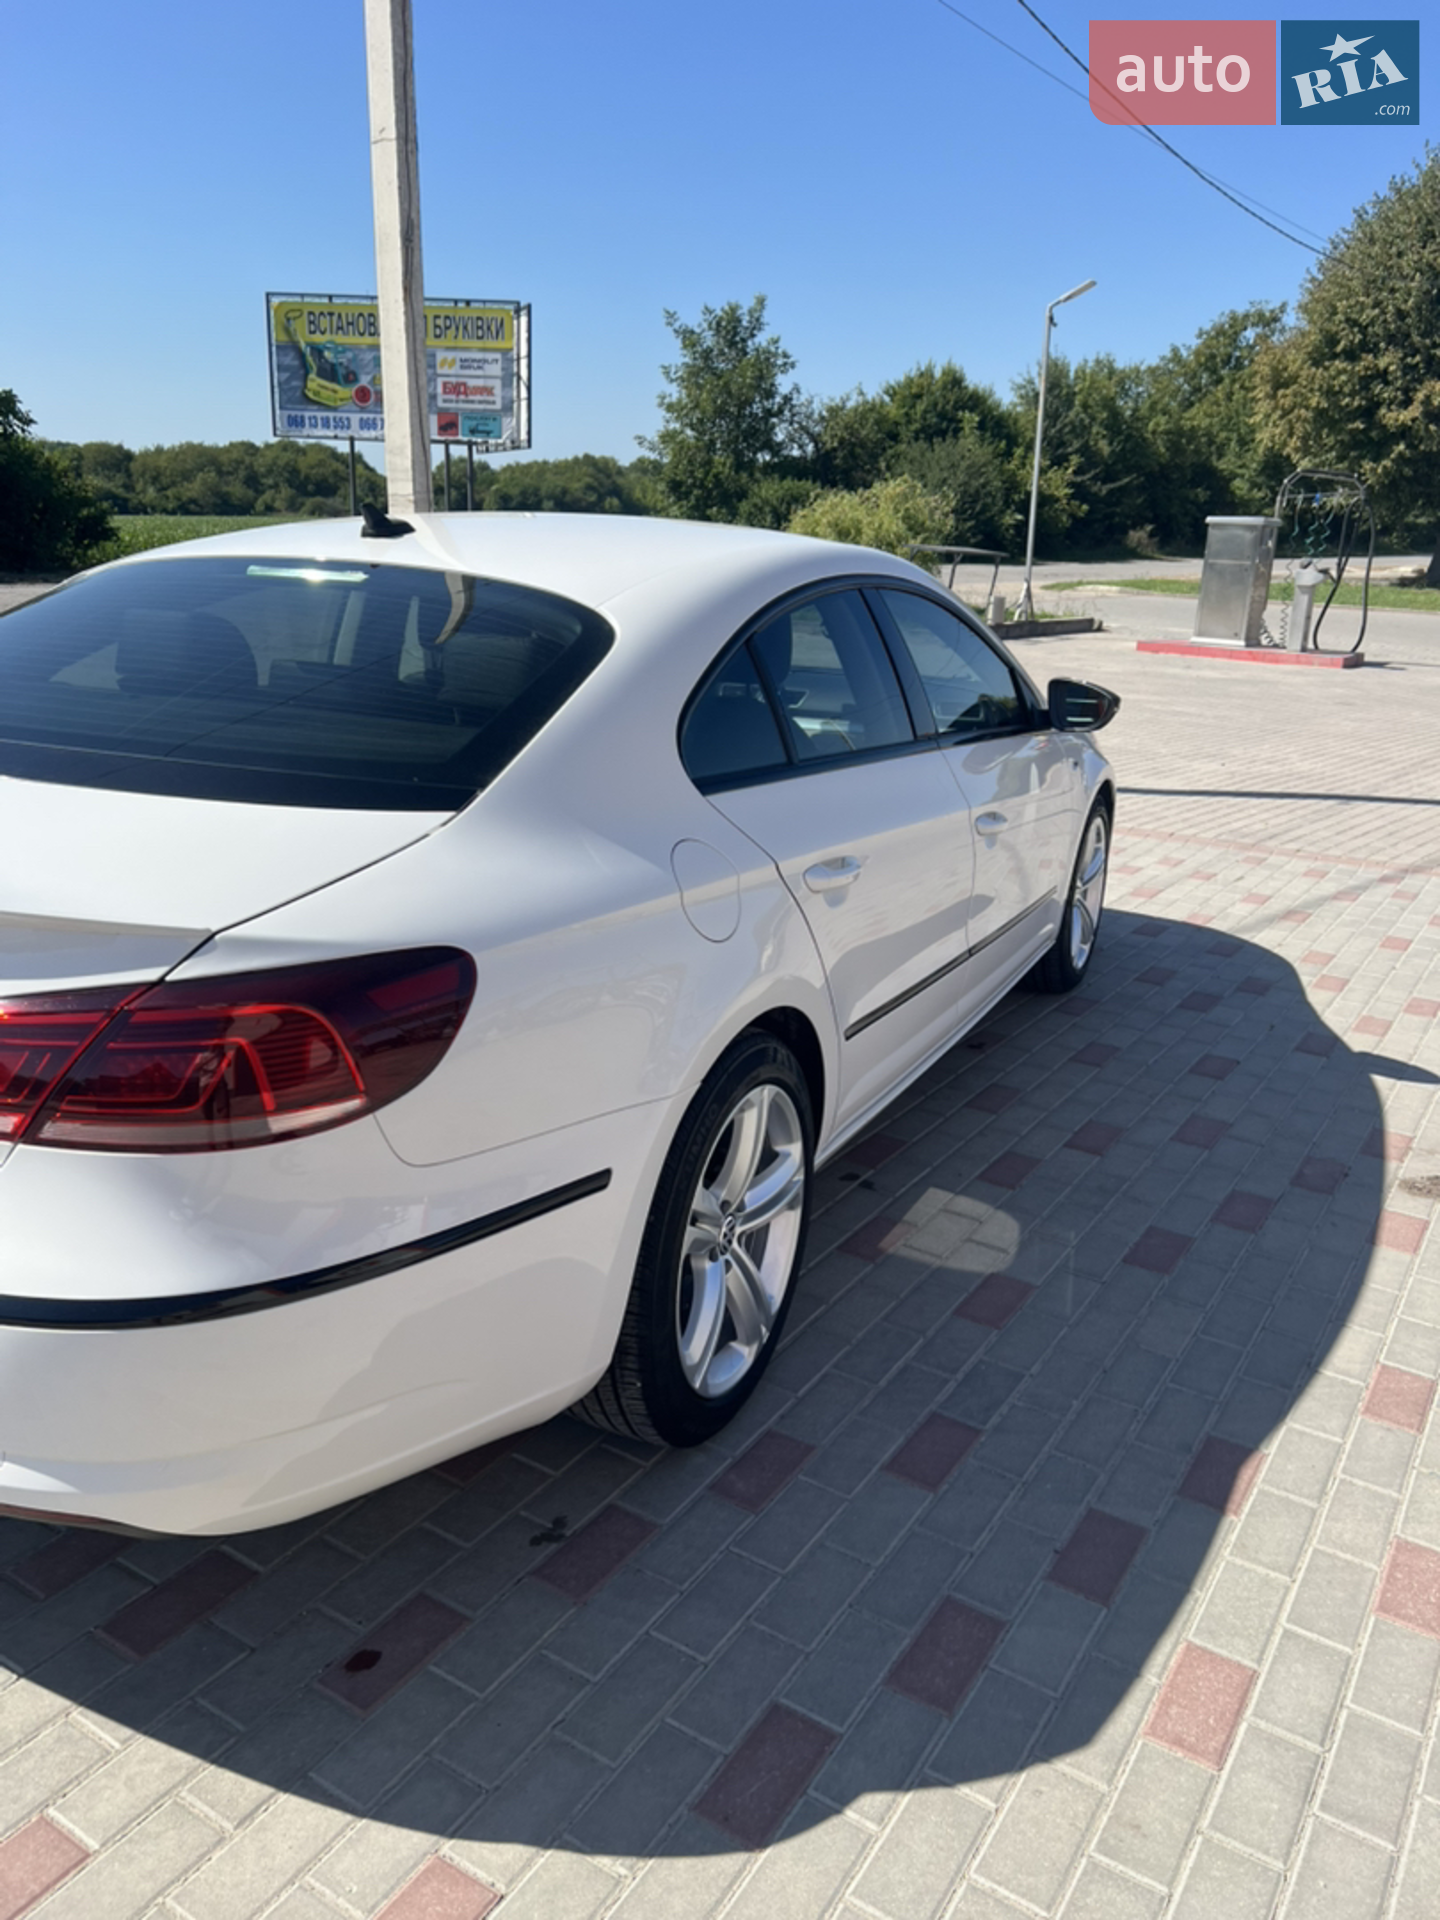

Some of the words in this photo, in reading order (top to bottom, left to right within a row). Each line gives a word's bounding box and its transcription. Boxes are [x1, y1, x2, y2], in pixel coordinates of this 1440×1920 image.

[307, 311, 380, 337] ВСТАНОВ
[433, 314, 505, 341] БРУКІВКИ
[308, 415, 319, 429] 13
